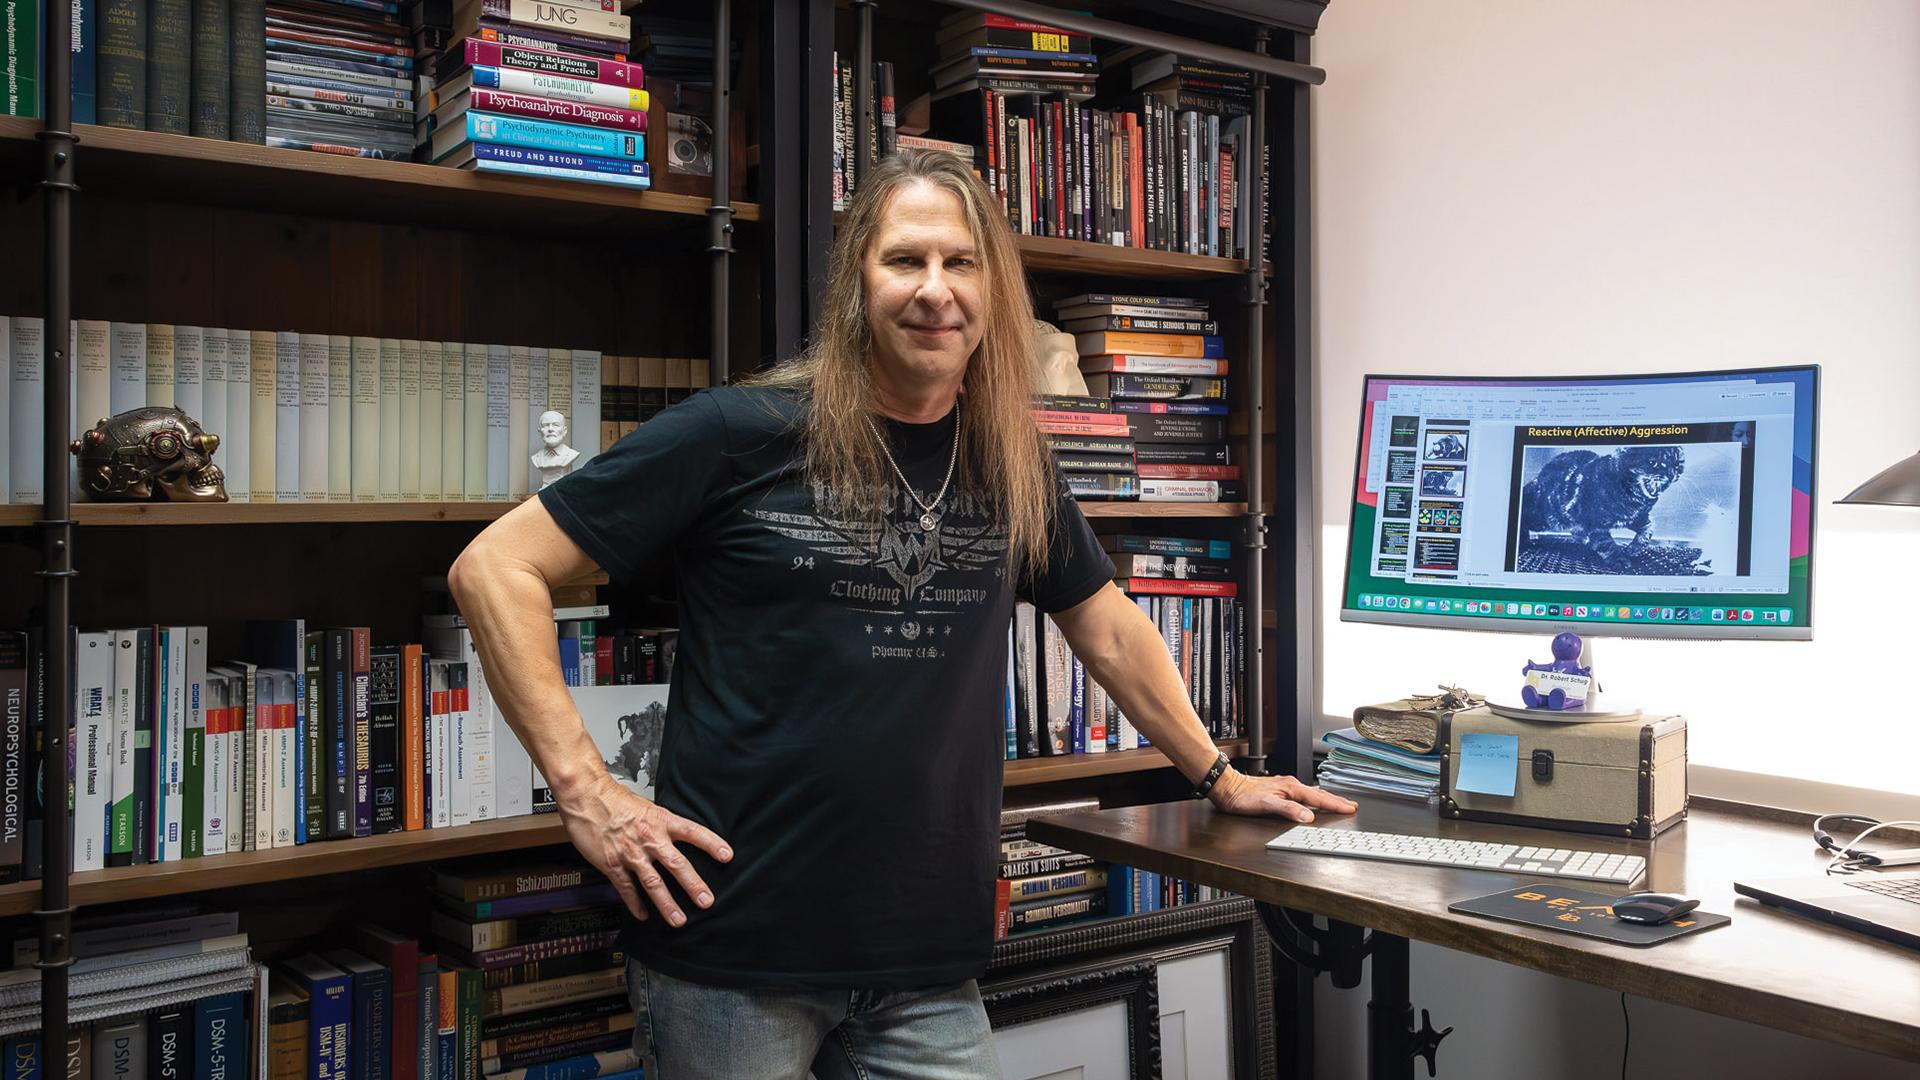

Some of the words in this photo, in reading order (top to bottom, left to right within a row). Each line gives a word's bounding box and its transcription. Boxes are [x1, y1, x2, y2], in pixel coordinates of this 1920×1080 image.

[534, 4, 578, 24] JUNG
[505, 56, 534, 68] Theory
[536, 60, 558, 70] and
[560, 64, 596, 76] Practice
[514, 50, 544, 62] Object
[546, 54, 587, 68] Relations
[8, 56, 18, 94] Diagnostic
[533, 73, 594, 94] PSYCHOANALYTIC
[843, 67, 852, 84] The
[488, 94, 570, 116] Psychoanalytic
[572, 104, 624, 124] Diagnosis
[844, 86, 853, 114] Minds
[1180, 96, 1197, 106] ANN
[1198, 98, 1216, 110] RULE
[502, 120, 565, 136] Psychodynamic
[566, 129, 606, 142] Psychiatry
[844, 116, 853, 126] of
[844, 126, 854, 148] Billy
[494, 148, 524, 160] FREUD
[526, 152, 544, 162] AND
[548, 154, 583, 166] BEYOND
[845, 148, 855, 190] Milligan
[1223, 154, 1232, 190] HUNTING
[1223, 193, 1232, 227] HUMANS
[1134, 320, 1158, 329] VIOLENCE
[1162, 321, 1185, 330] SERIOUS
[1186, 322, 1201, 330] THEFT
[1528, 427, 1572, 437] Reactive
[1574, 426, 1627, 438] (Affective)
[1630, 425, 1688, 437] Aggression
[790, 556, 815, 571] 94
[1183, 565, 1198, 573] EVIL
[829, 580, 901, 608] Clothing
[919, 585, 988, 606] Company
[1169, 610, 1179, 656] CRIMINAL
[872, 645, 913, 660] Phoenix
[1047, 632, 1055, 707] PSYCHIATRY
[1056, 638, 1064, 701] FORENSIC
[1570, 677, 1588, 685] Schug
[86, 687, 102, 718] WRAT4
[356, 676, 369, 718] Clinician's
[88, 724, 97, 768] Professional
[356, 719, 369, 770] THESAURUS
[4, 688, 20, 844] NEUROPSYCHOLOGICAL
[88, 770, 97, 795] Manual
[359, 775, 367, 784] 7th
[359, 785, 367, 803] Edition
[1003, 863, 1029, 878] SNAKES
[1030, 862, 1039, 873] IN
[1040, 859, 1060, 872] SUITS
[516, 870, 582, 894] Schizophrenia
[1022, 880, 1050, 896] CRIMINAL
[1051, 874, 1088, 890] PERSONALITY
[1025, 907, 1052, 923] CRIMINAL
[1053, 900, 1090, 918] PERSONALITY
[424, 986, 433, 1022] Forensic
[334, 1023, 346, 1070] DISORDERS
[319, 1062, 331, 1078] and
